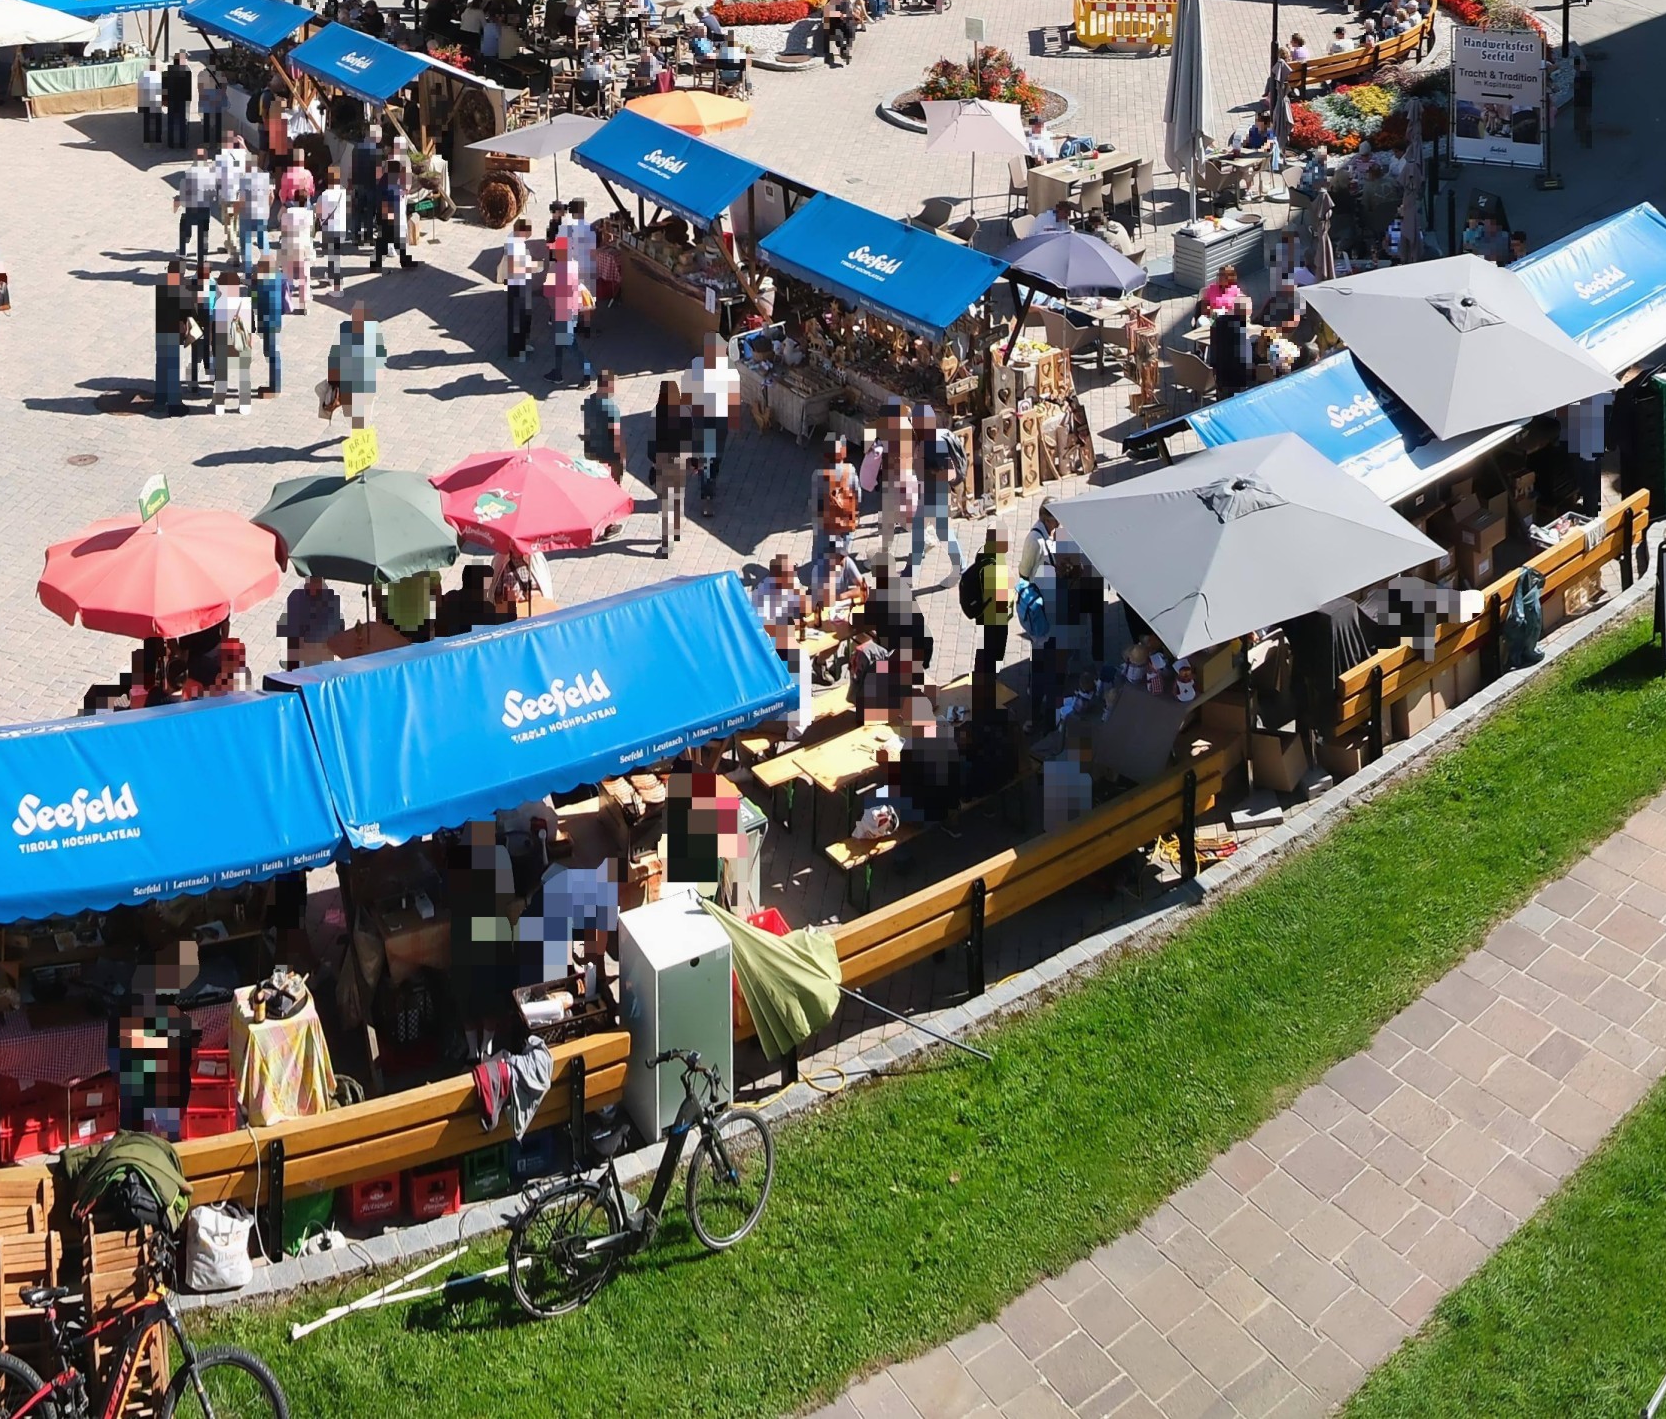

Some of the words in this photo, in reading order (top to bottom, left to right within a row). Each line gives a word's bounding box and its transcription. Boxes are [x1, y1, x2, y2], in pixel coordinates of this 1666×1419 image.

[1463, 36, 1534, 53] Handwerksfest
[1481, 51, 1515, 63] Seefeld
[1459, 68, 1489, 79] Tracht
[1490, 70, 1497, 79] &
[1499, 70, 1538, 83] Tradition
[644, 150, 688, 174] Seefeld
[848, 246, 903, 275] Seefeld
[502, 669, 612, 728] Seefeld
[548, 705, 617, 737] HOCHPLATEAU
[619, 749, 645, 764] Seefeld
[652, 736, 685, 754] Leutasch
[691, 724, 720, 741] Mösern
[726, 714, 747, 729] Reith
[752, 701, 785, 718] Scharnitz
[12, 782, 140, 836] Seefeld
[19, 838, 59, 854] TIROLS
[61, 827, 142, 849] HOCHPLATEAU
[133, 883, 162, 897] Seefeld
[173, 874, 210, 891] Leutasch
[221, 865, 252, 881] Mösern
[262, 860, 284, 872] Reith
[293, 848, 332, 865] Scharnitz
